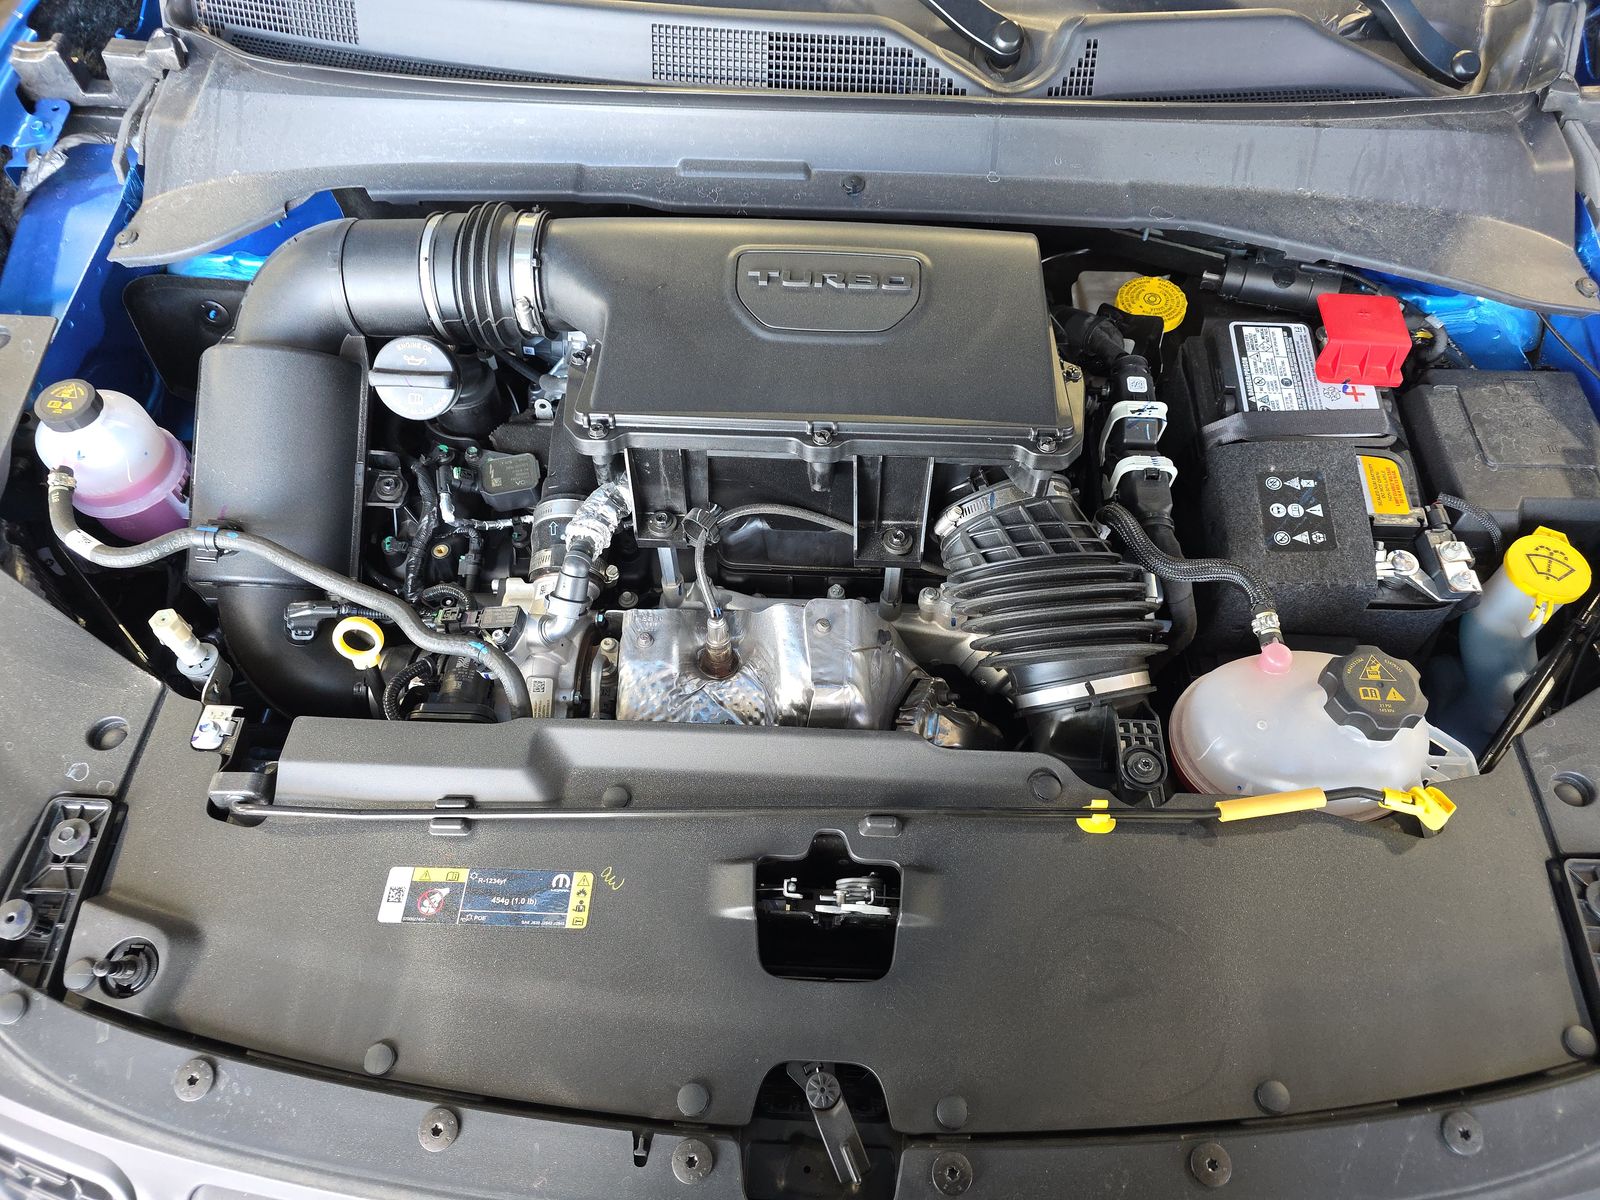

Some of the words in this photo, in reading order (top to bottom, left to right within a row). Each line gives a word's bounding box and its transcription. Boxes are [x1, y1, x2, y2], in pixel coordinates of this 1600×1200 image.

[748, 269, 912, 290] TURBO
[491, 896, 510, 905] 454g
[511, 897, 526, 905] (1.0
